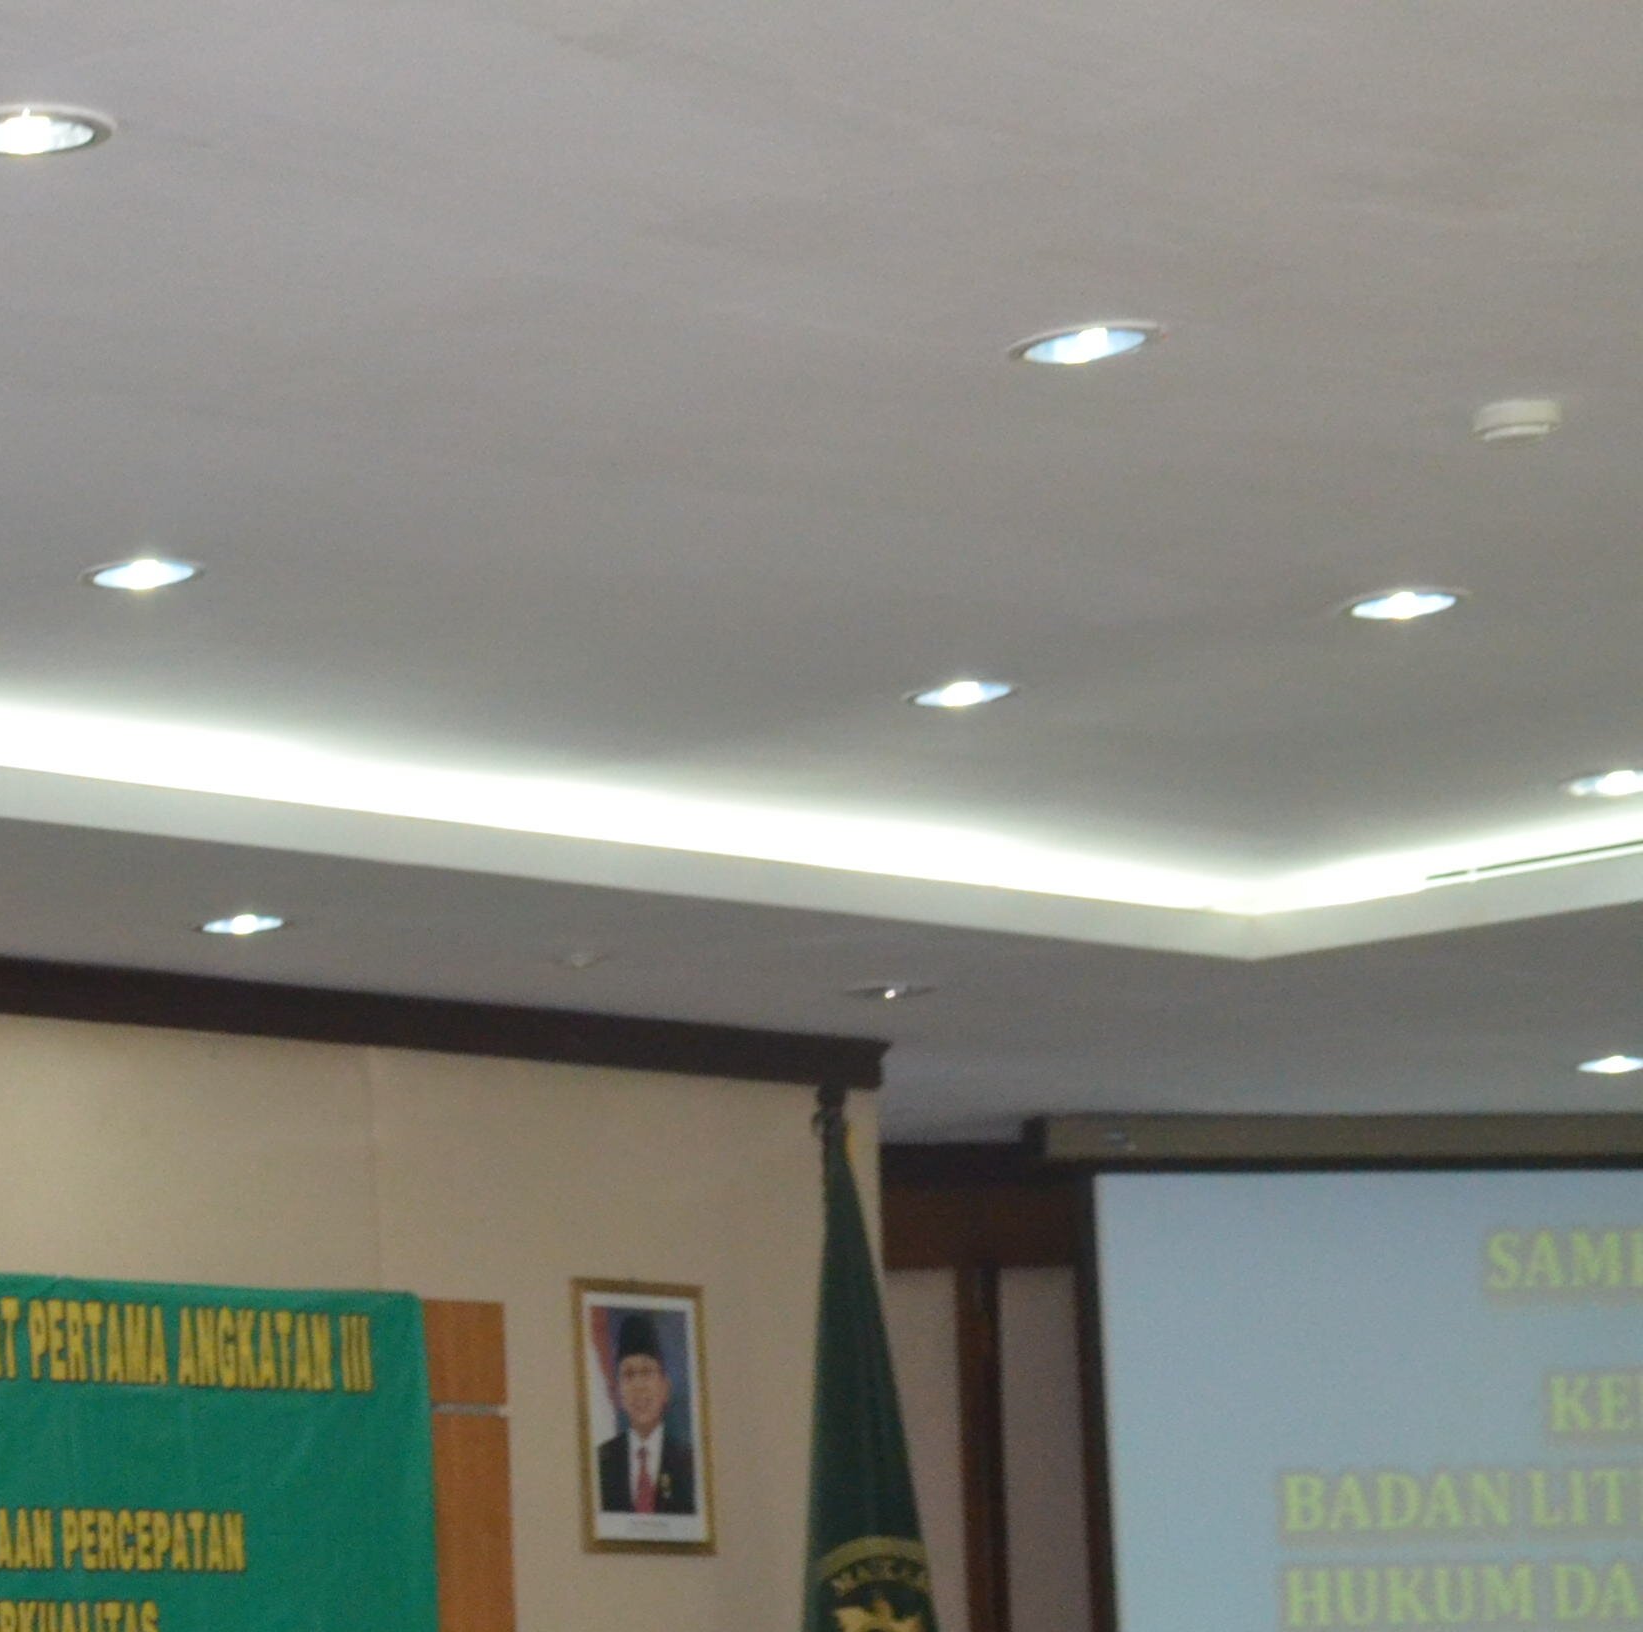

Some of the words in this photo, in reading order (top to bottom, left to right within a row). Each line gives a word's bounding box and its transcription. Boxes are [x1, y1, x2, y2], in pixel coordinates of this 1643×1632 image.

[26, 1298, 170, 1385] PERTAMA
[177, 1306, 333, 1391] ANGKATAN
[1549, 1372, 1643, 1434] KE
[1283, 1470, 1514, 1534] BADAN
[1528, 1465, 1643, 1529] LIT
[61, 1508, 246, 1572] PERCEPATAN
[1285, 1562, 1539, 1628] HUKUM
[1552, 1560, 1643, 1622] DA
